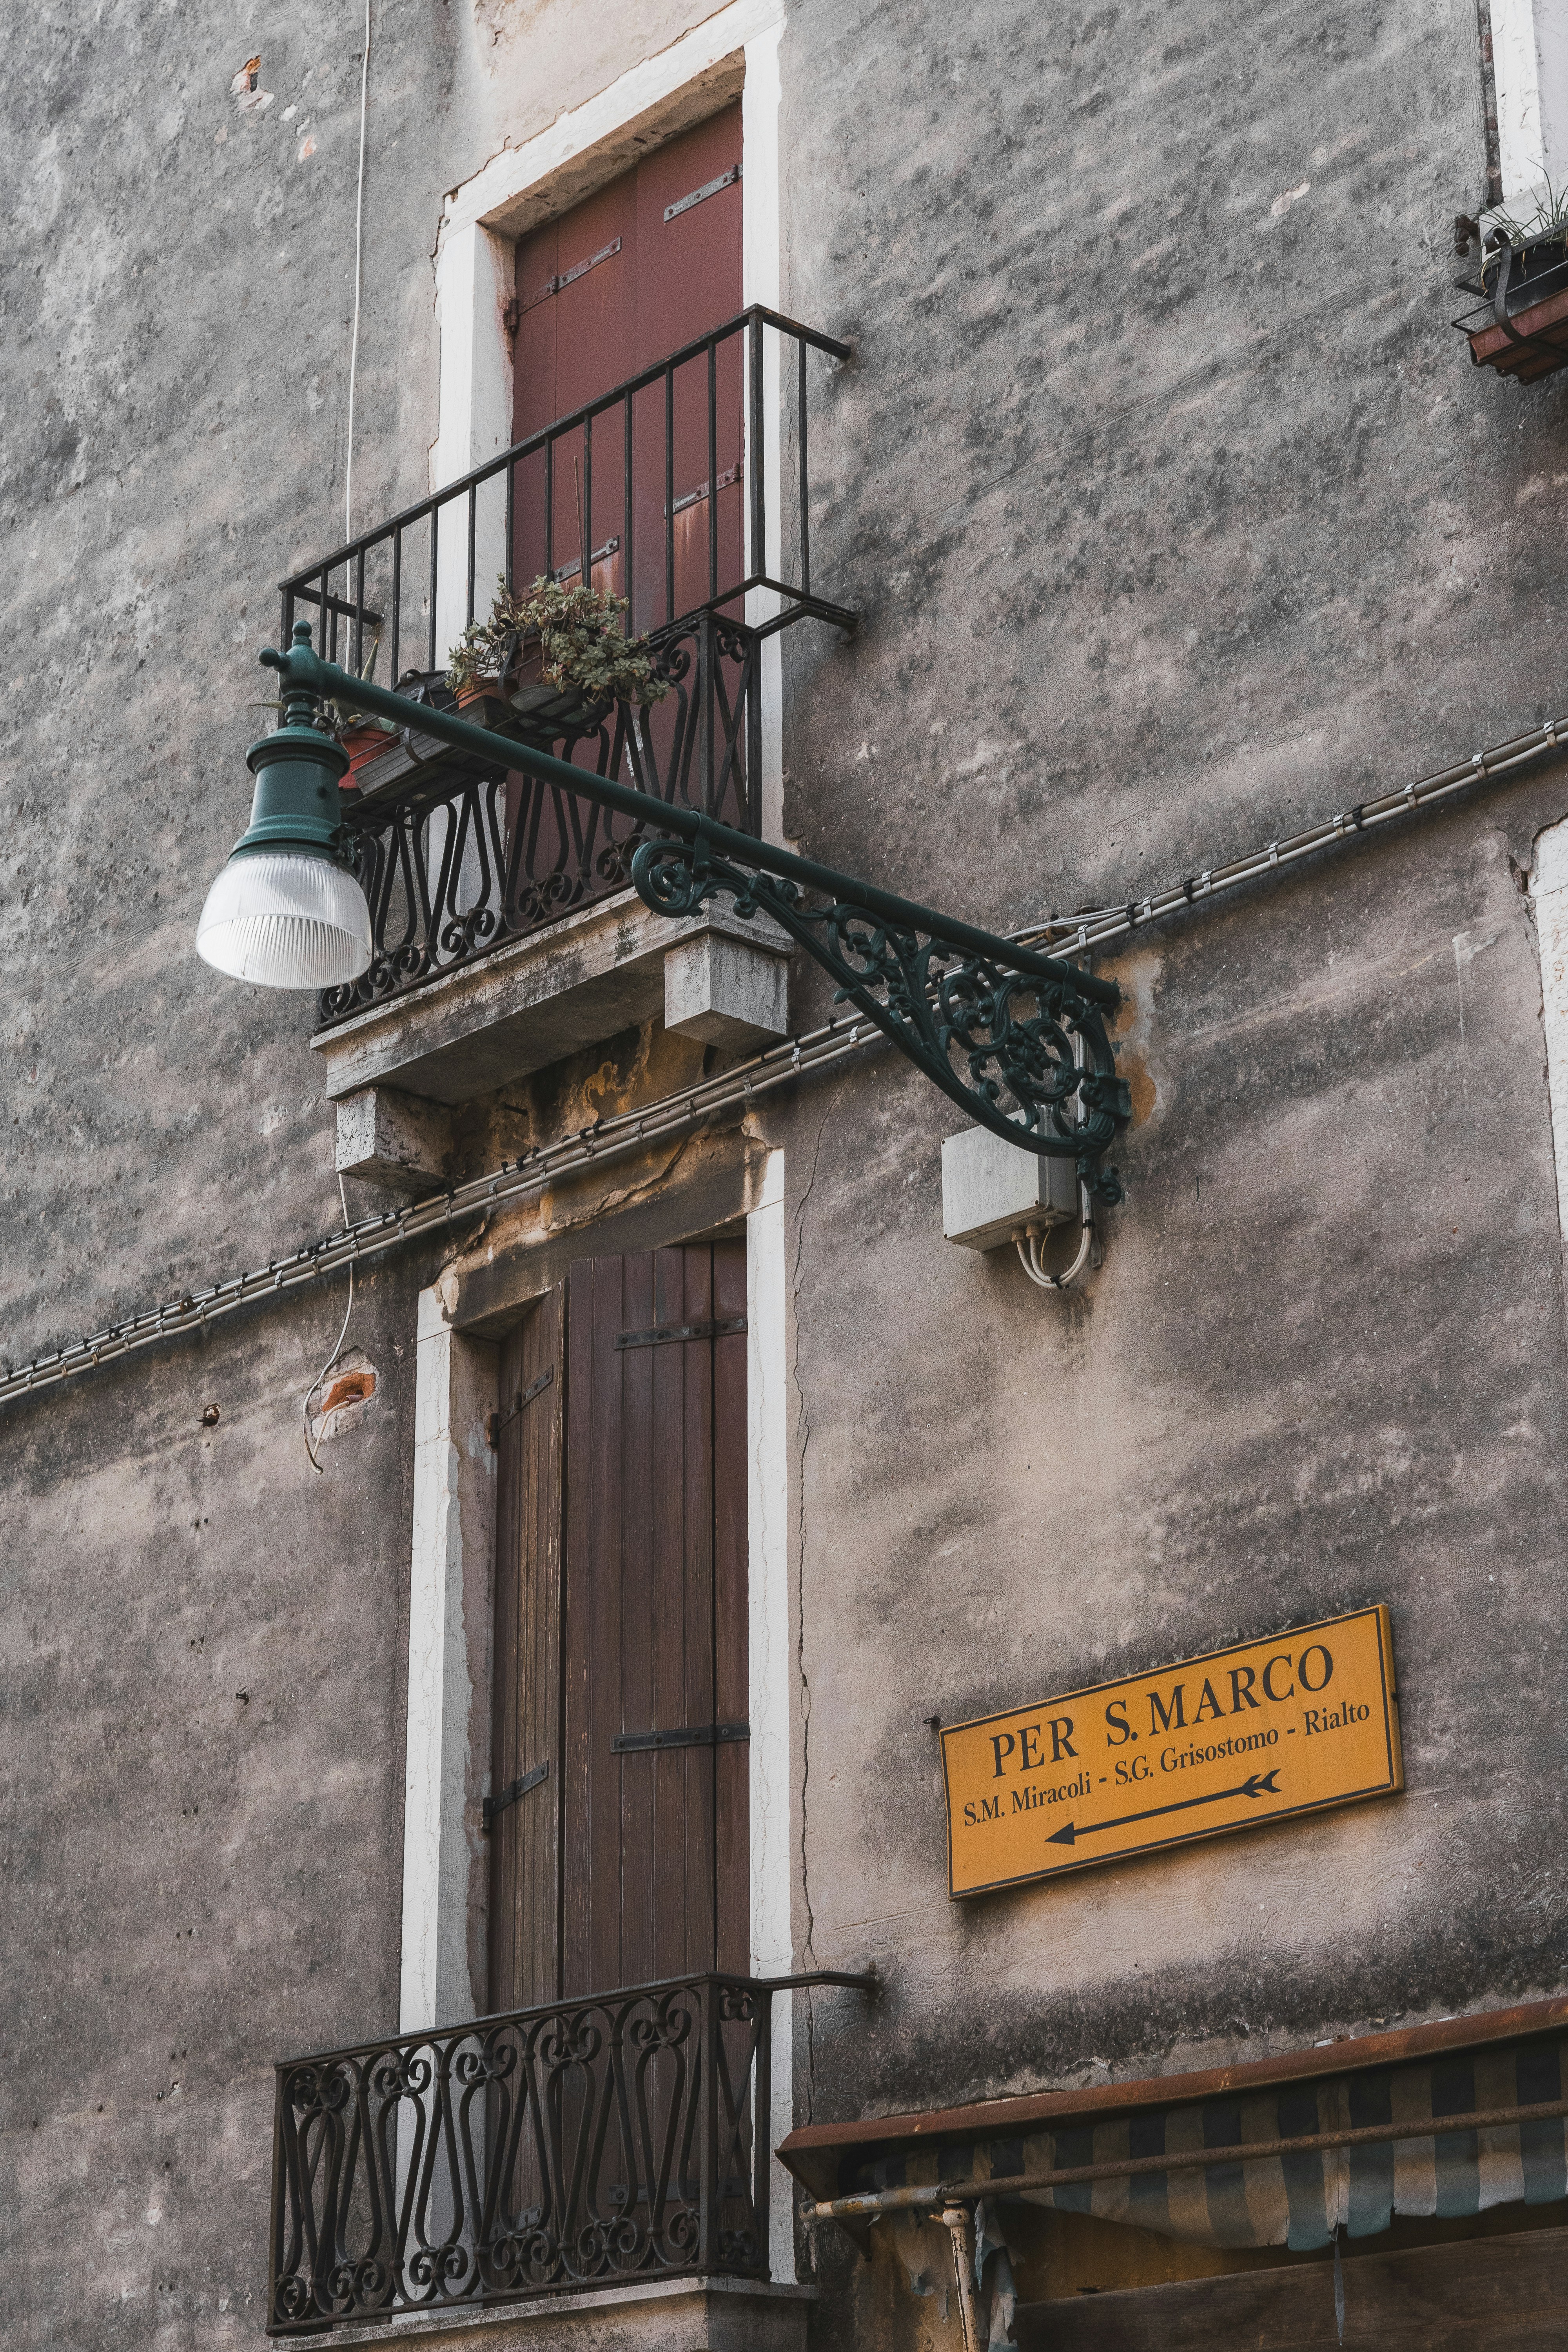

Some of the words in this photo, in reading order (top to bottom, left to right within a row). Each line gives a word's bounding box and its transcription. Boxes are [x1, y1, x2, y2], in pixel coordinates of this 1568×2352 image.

[989, 1716, 1079, 1779] PER
[1011, 1771, 1092, 1813] Miracoli
[1114, 1755, 1154, 1786] S.G.
[1160, 1729, 1279, 1773] Grisostomo
[1303, 1704, 1370, 1736] Rialto
